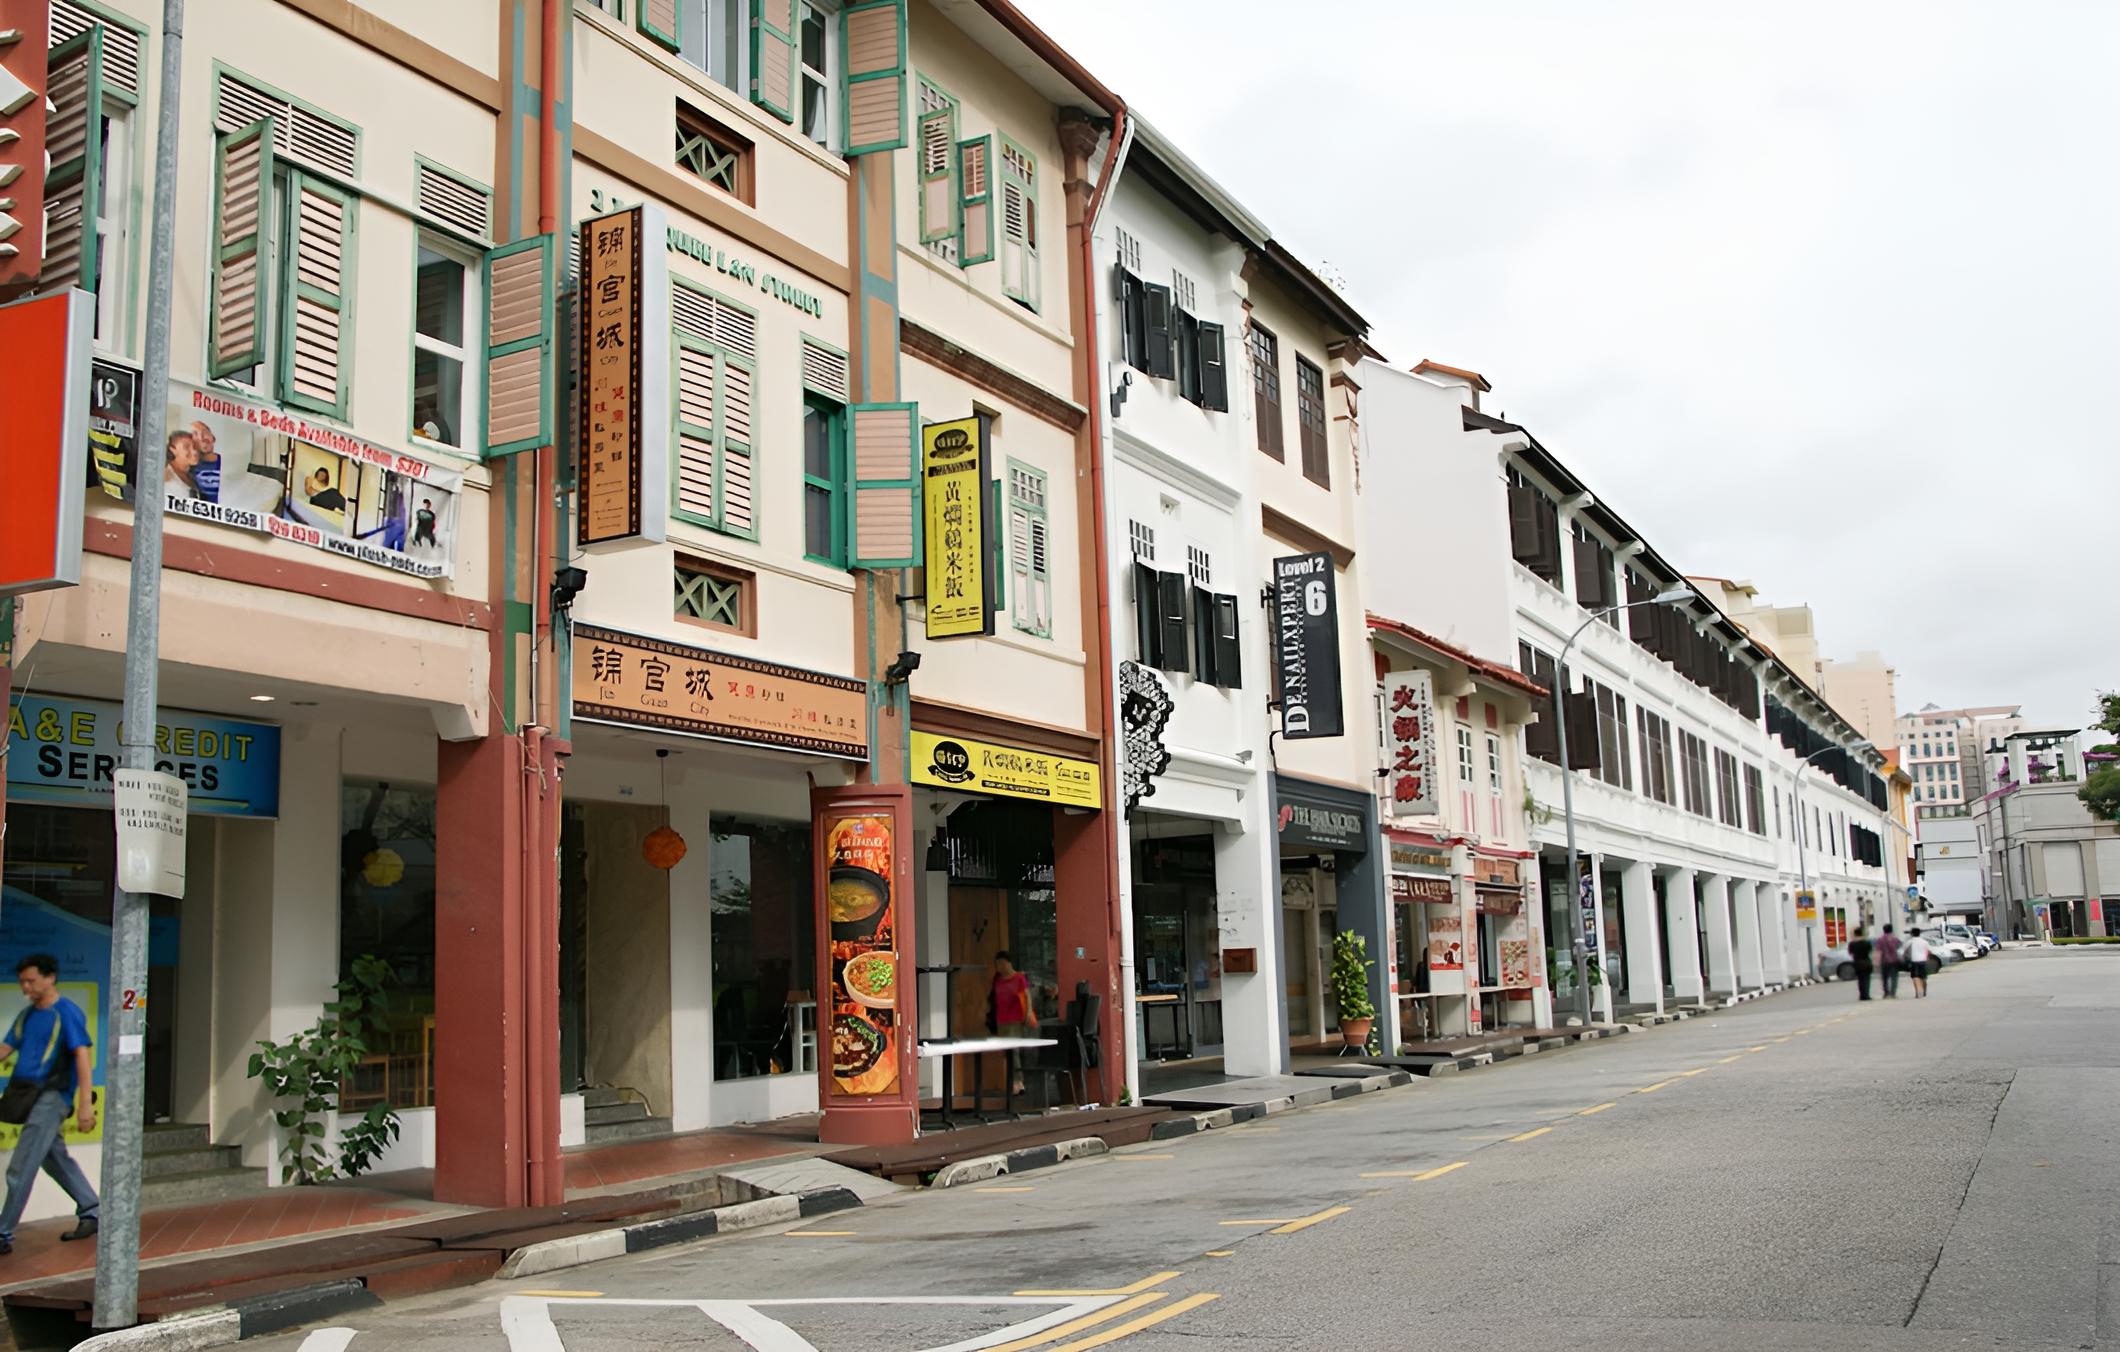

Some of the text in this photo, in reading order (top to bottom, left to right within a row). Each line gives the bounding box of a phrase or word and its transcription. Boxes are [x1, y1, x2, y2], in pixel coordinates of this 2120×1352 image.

[716, 250, 757, 288] LAN
[193, 390, 243, 420] Rooms
[260, 409, 295, 434] Beds
[298, 421, 360, 457] Available
[362, 443, 393, 468] from
[167, 495, 190, 514] Tel:
[1277, 556, 1326, 577] Level 2
[1305, 579, 1328, 617] 6
[10, 704, 253, 762] A&E REDIT
[37, 744, 219, 791] SERES
